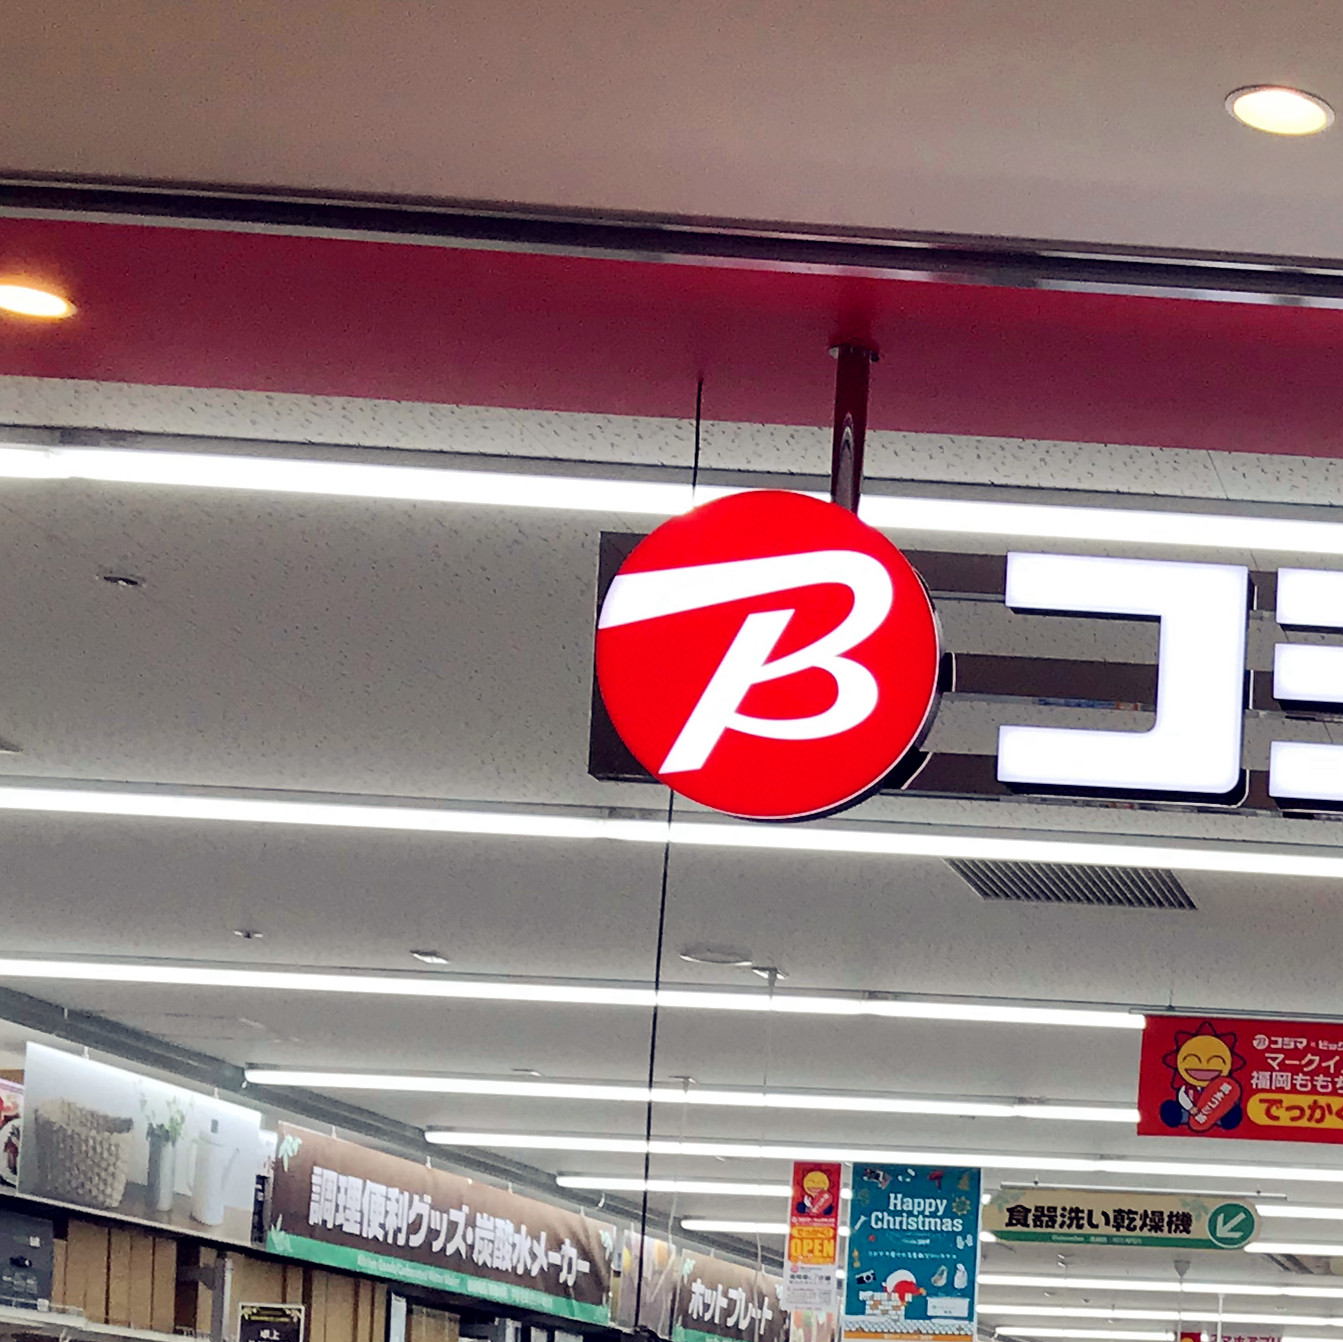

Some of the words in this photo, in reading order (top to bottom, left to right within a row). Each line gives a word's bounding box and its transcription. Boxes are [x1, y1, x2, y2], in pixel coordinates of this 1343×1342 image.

[889, 1193, 947, 1215] Happy
[308, 1165, 591, 1287] 調理便利グッズ・炭酸水メーカー
[870, 1212, 963, 1231] Christmas
[1005, 1203, 1193, 1235] 食器洗い乾燥機
[790, 1238, 835, 1257] OPEN
[688, 1278, 773, 1335] ホットプレート
